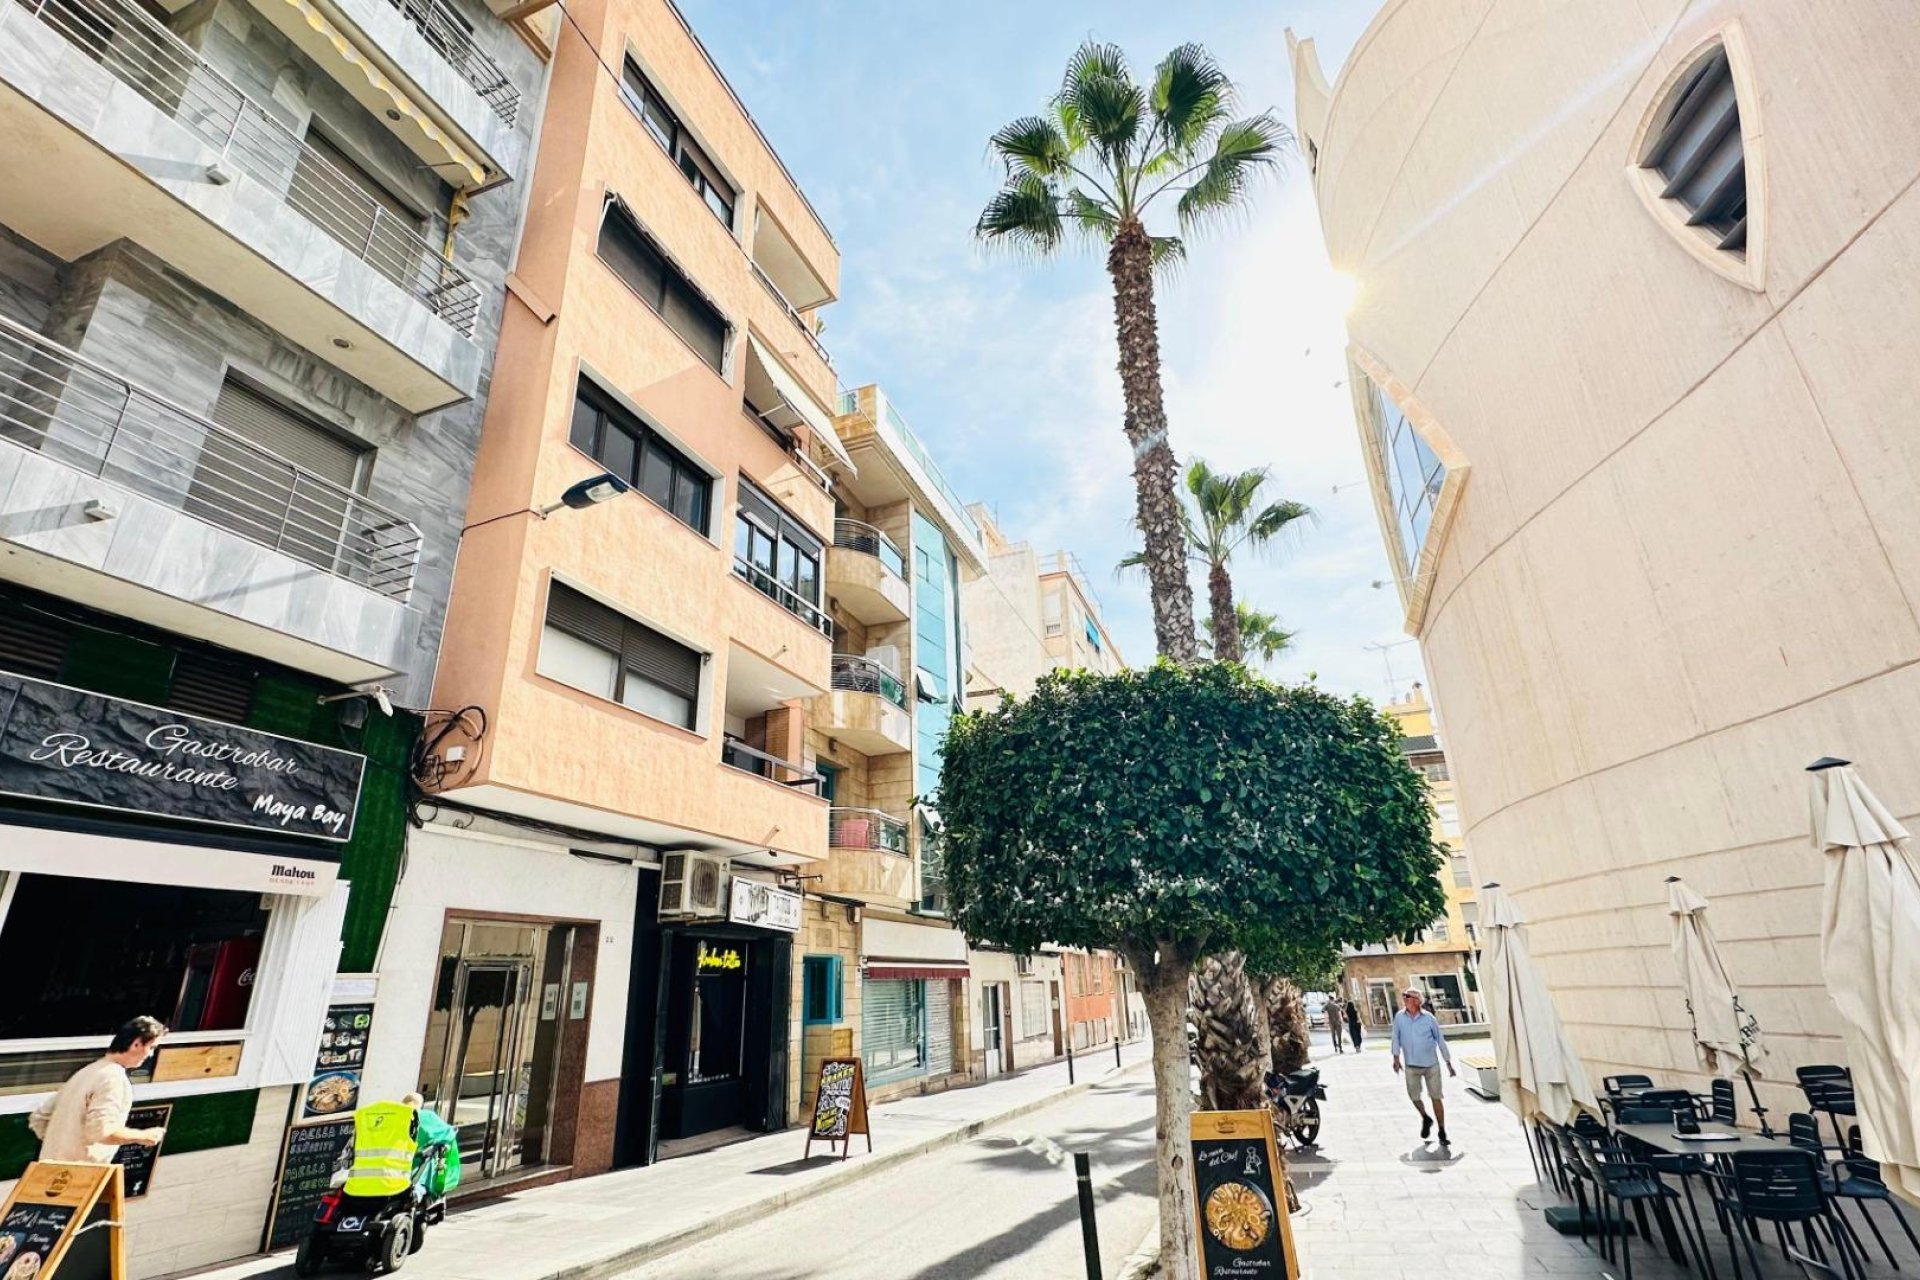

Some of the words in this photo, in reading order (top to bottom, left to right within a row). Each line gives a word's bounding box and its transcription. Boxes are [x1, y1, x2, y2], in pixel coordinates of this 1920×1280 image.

[30, 733, 239, 791] Restaurante
[145, 724, 301, 775] Gastrobar
[252, 794, 305, 826] Maya
[311, 804, 346, 832] Bay
[271, 864, 315, 879] Mahou
